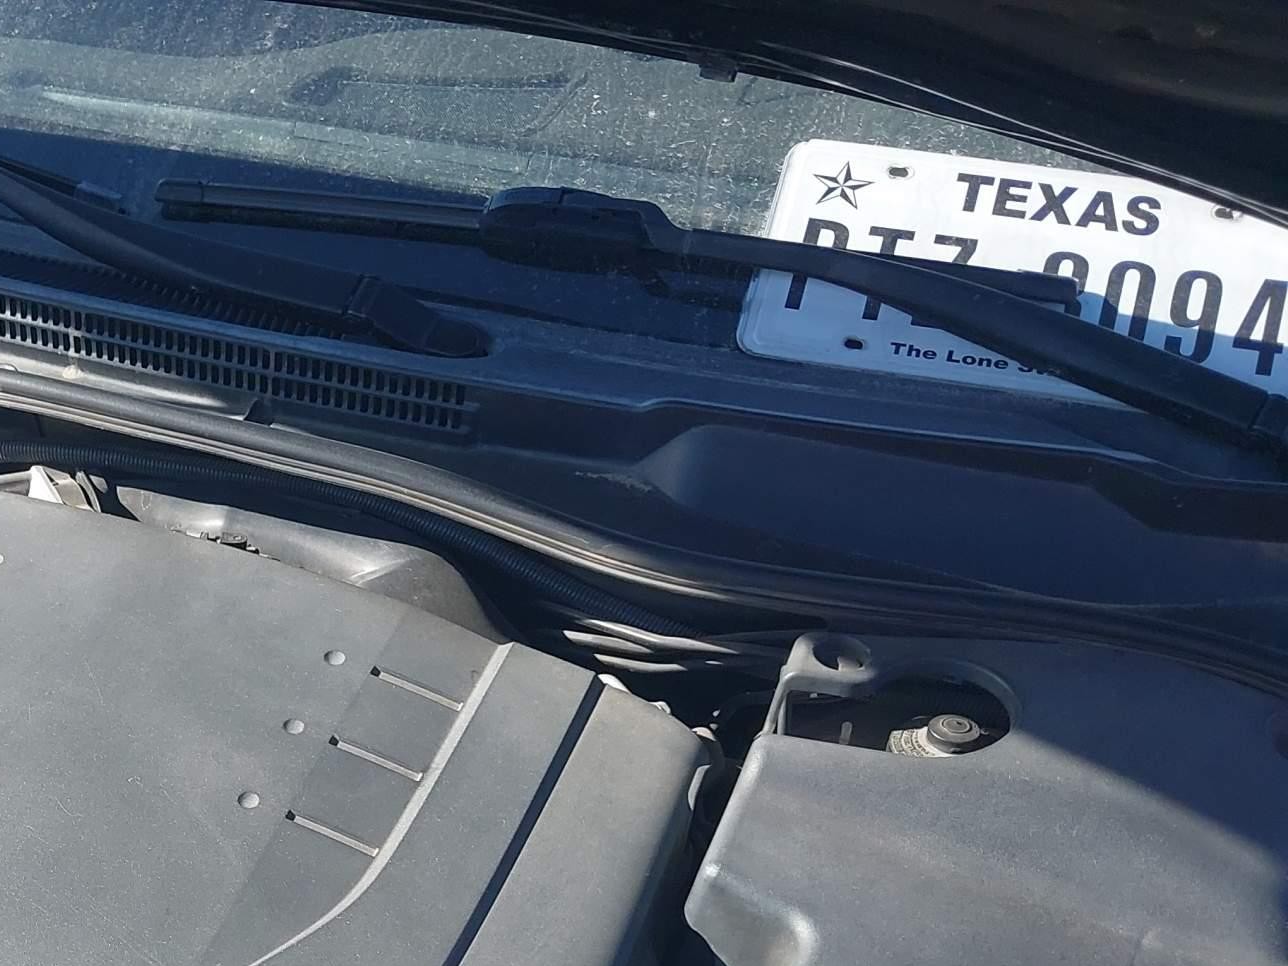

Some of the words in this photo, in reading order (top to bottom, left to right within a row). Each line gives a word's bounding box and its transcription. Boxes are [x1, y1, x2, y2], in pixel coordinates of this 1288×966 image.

[956, 172, 1162, 236] TEXAS
[890, 341, 937, 360] The
[945, 350, 1009, 370] Lone
